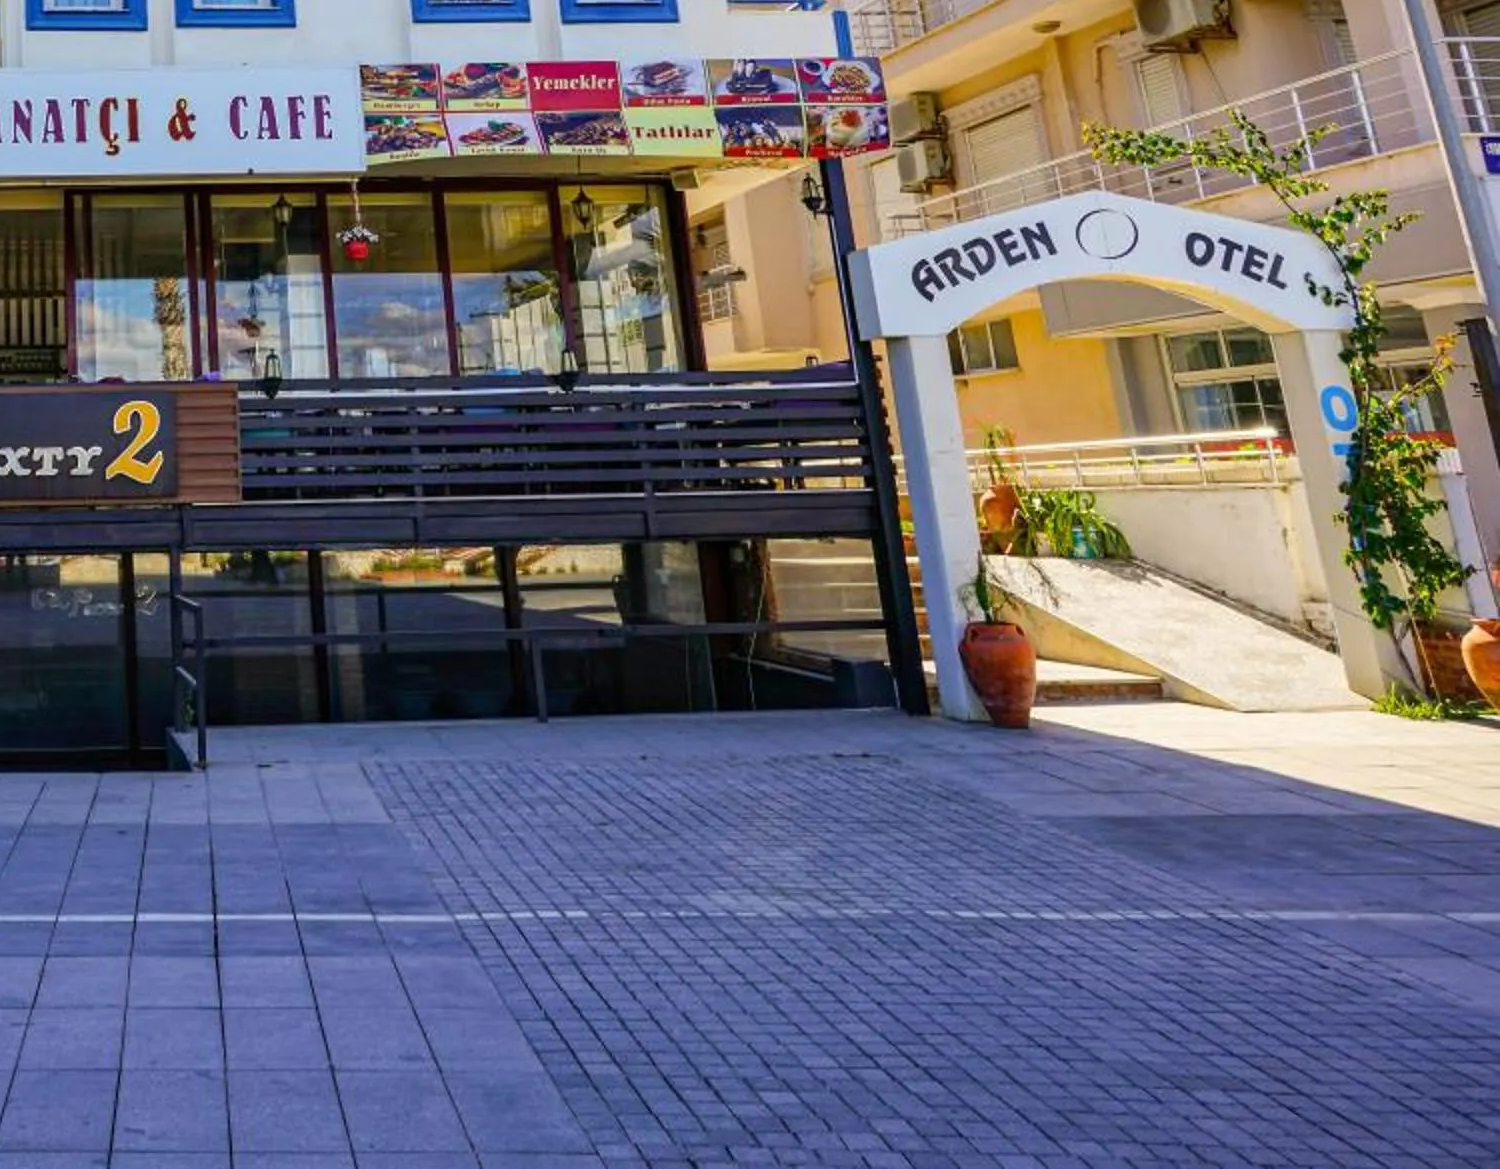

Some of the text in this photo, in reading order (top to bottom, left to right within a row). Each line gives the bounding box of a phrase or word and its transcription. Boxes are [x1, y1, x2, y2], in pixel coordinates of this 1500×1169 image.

[532, 74, 616, 91] Yemekler
[166, 98, 197, 143] &
[228, 94, 334, 141] CAFE
[631, 124, 714, 140] Tatlılar
[910, 220, 1288, 303] ARDEN OTEL
[104, 399, 165, 485] 2
